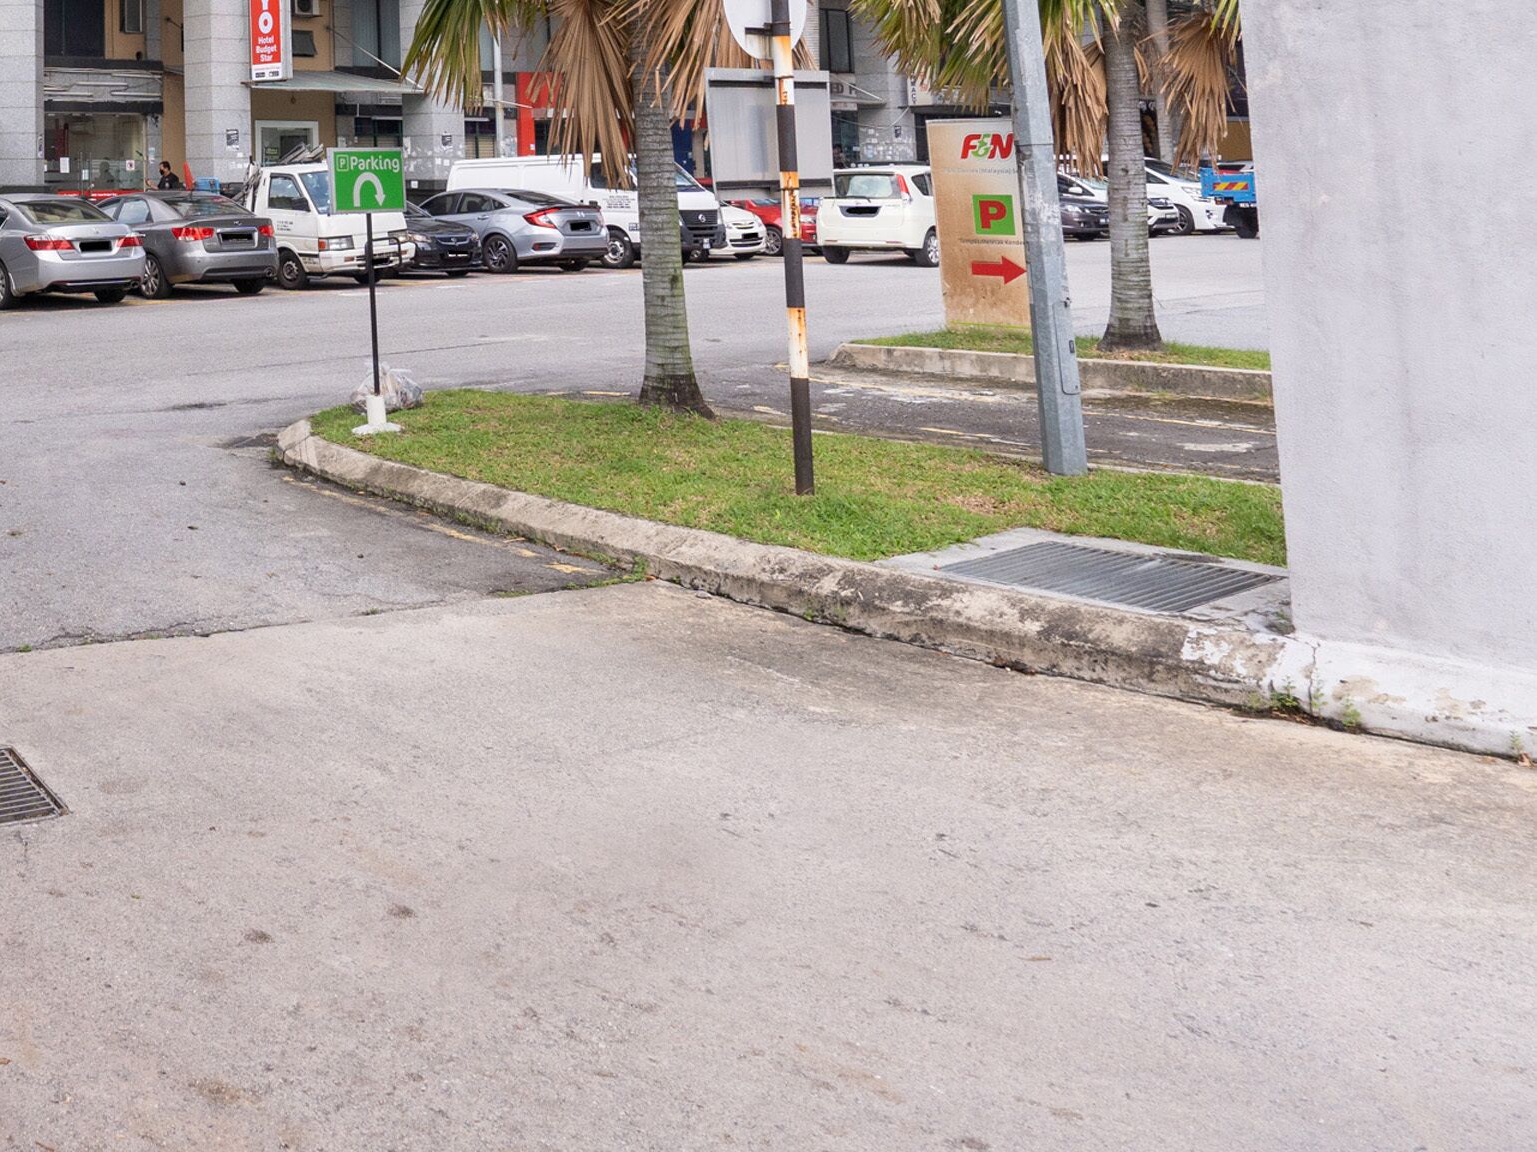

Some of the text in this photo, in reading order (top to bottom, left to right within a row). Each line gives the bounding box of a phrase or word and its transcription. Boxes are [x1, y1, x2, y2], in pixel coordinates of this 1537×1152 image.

[258, 35, 274, 45] Hotel
[255, 44, 277, 55] Budget
[260, 53, 273, 62] Star
[960, 132, 1015, 160] F&N
[350, 154, 400, 173] Parking
[979, 200, 1007, 229] P
